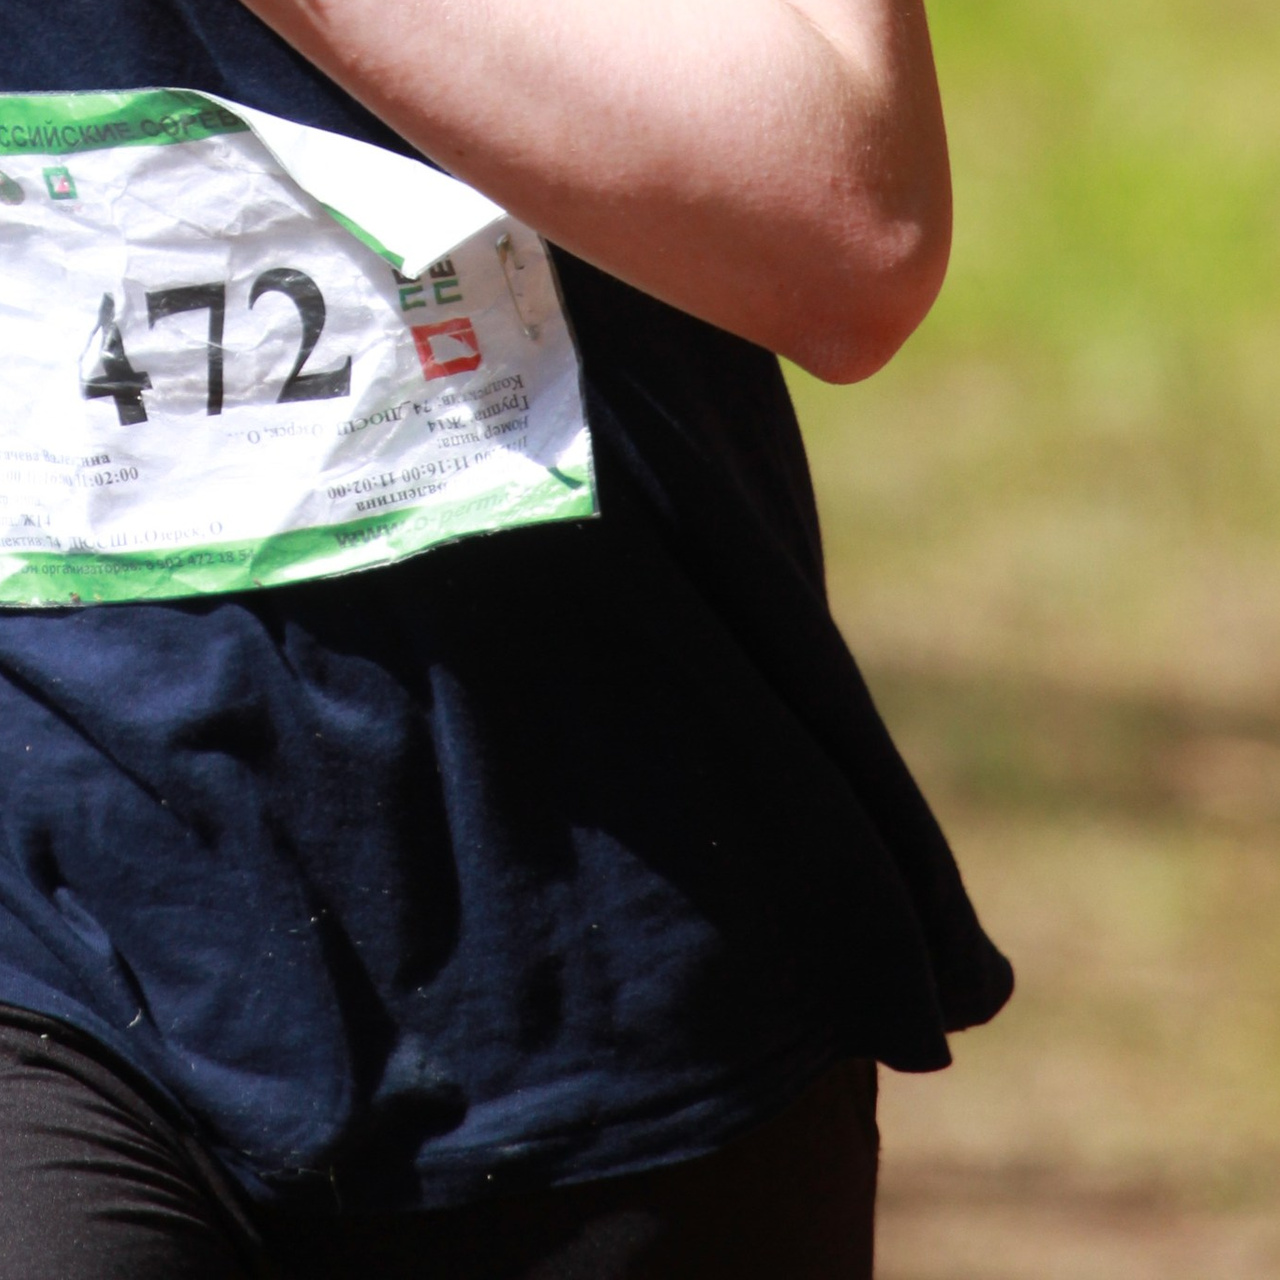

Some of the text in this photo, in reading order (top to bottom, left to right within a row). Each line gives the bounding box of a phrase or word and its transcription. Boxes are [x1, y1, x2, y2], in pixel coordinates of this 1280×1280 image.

[81, 268, 352, 426] 472
[42, 449, 112, 467] Валеина
[401, 451, 470, 483] 11:16:00
[327, 473, 396, 501] 11:02:00
[186, 554, 216, 568] 472
[218, 550, 235, 564] 18
